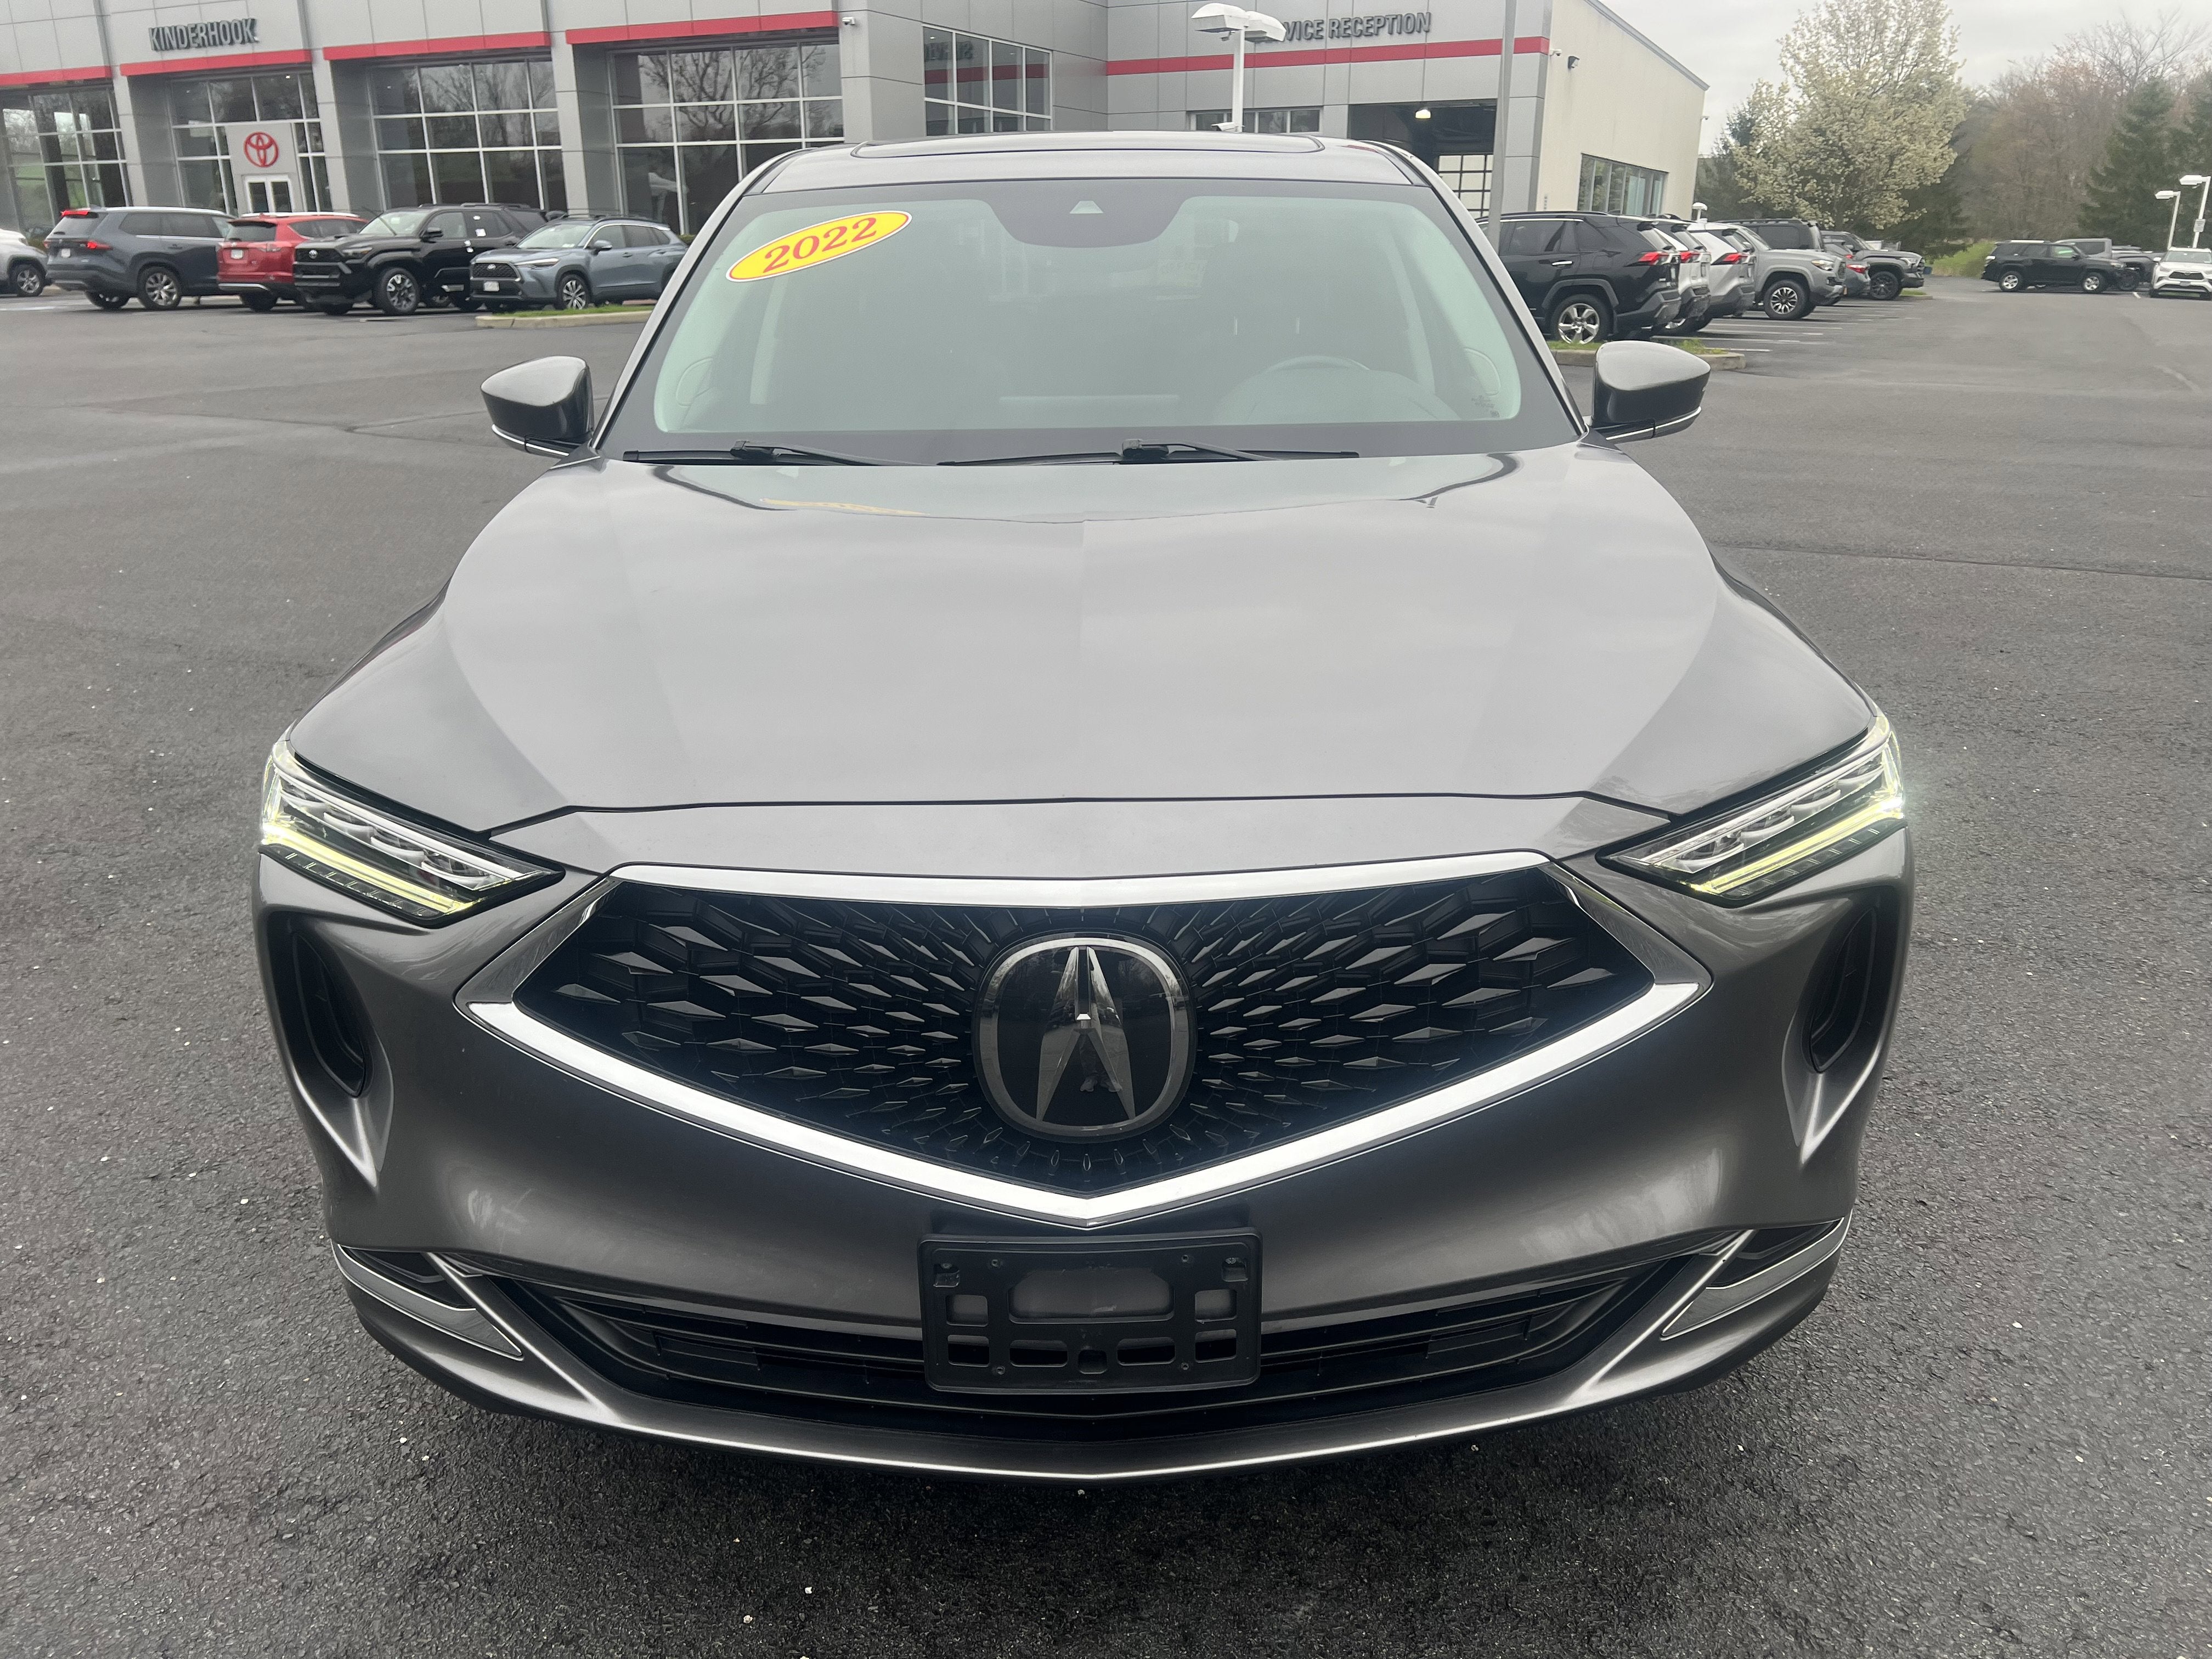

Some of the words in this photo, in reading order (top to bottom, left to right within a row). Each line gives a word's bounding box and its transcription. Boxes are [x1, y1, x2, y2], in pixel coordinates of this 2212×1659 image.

[148, 18, 258, 51] KINDERHOOK
[1284, 19, 1324, 41] VICE
[1328, 12, 1431, 38] RECEPTION
[763, 217, 876, 273] 2022
